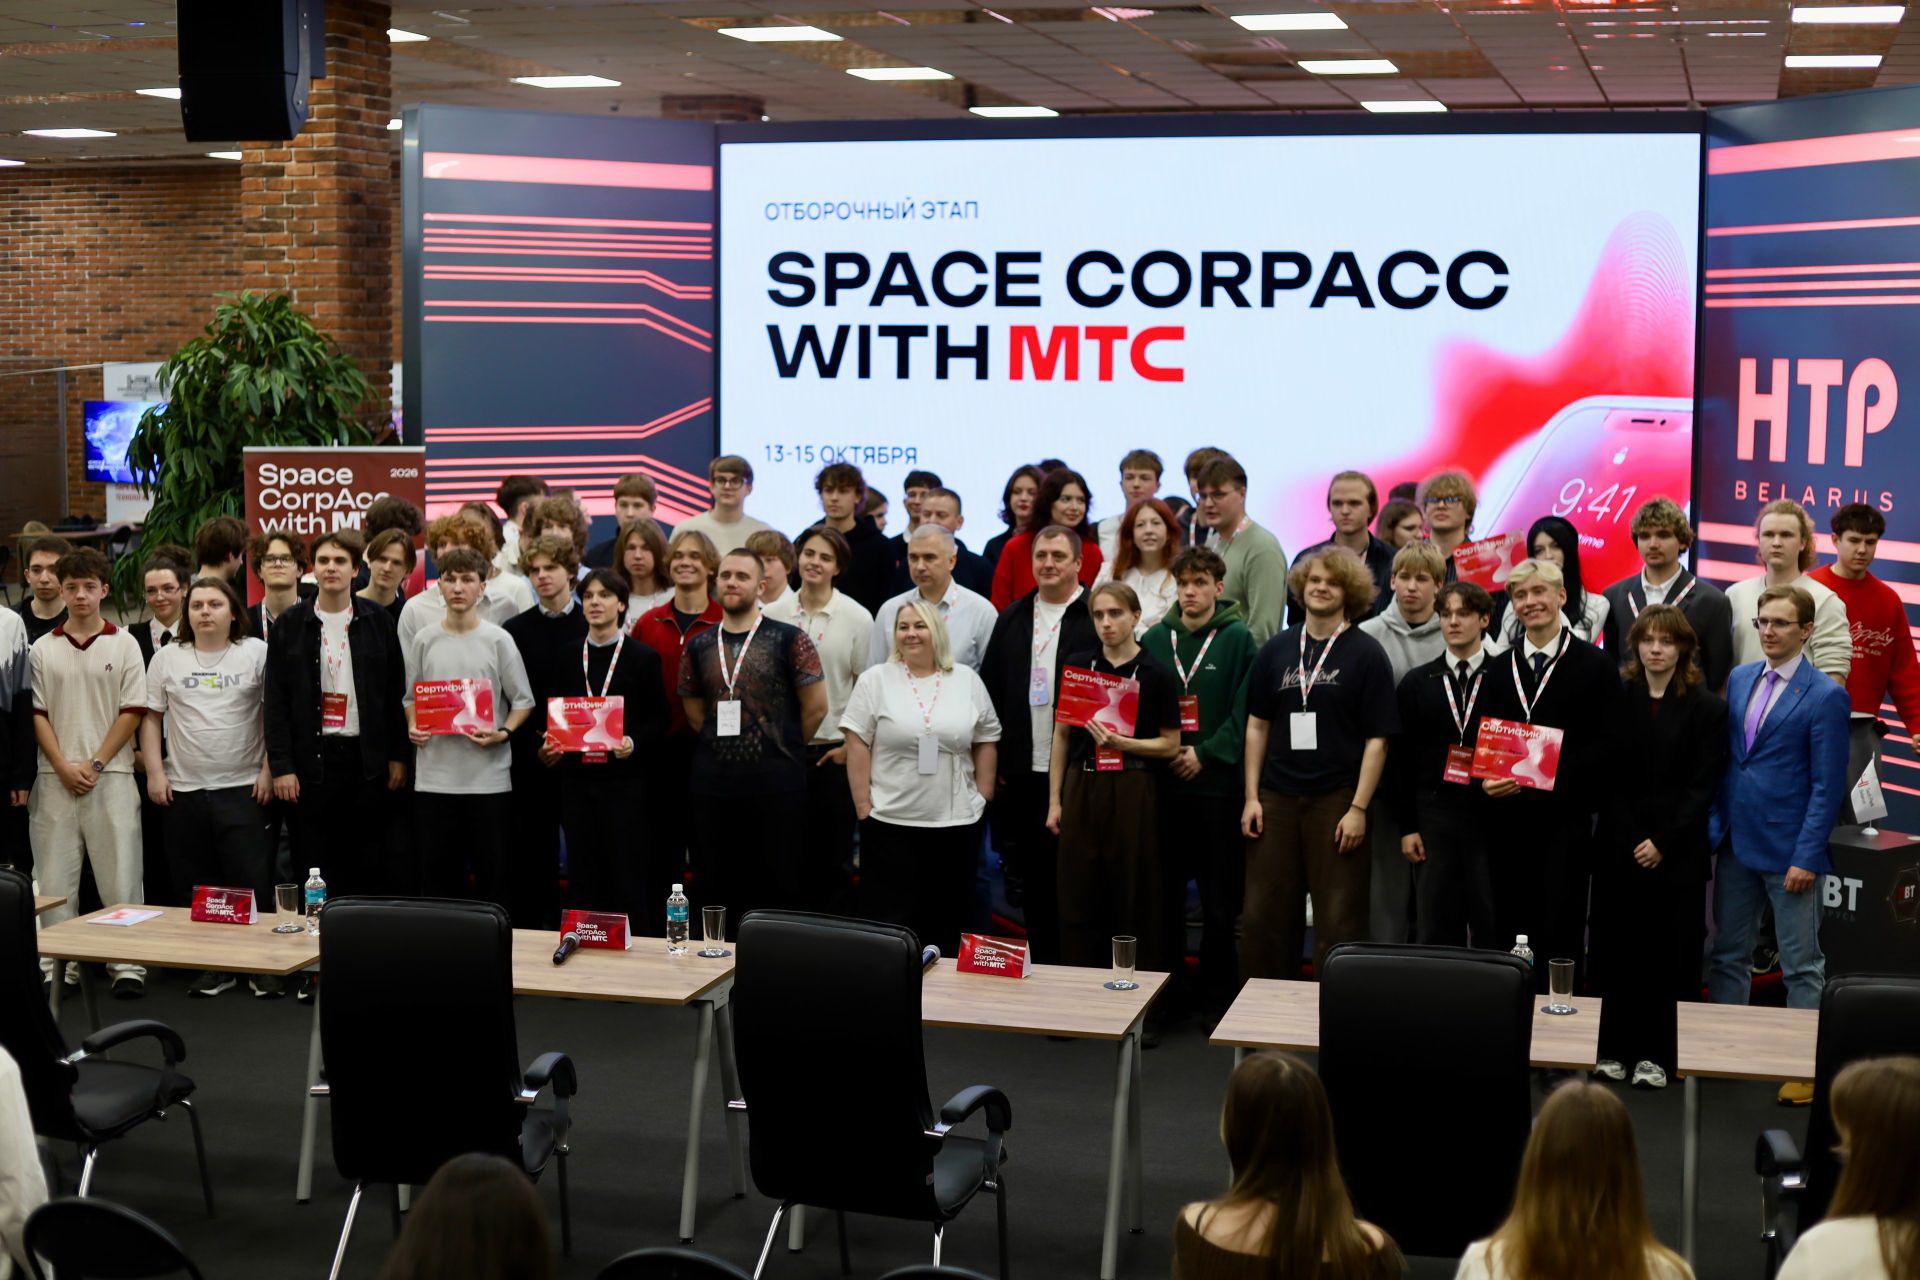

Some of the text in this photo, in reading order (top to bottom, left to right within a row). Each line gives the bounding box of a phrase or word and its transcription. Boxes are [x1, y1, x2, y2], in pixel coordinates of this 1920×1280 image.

[765, 196, 979, 221] ОТБОРОЧНЫЙ ЭТАП
[767, 249, 1510, 310] SPACE CORPACC
[766, 324, 990, 380] WITH
[1736, 356, 1899, 467] HTP
[765, 444, 918, 468] 13-15 ОКТЯБРЯ
[258, 463, 354, 490] Space
[390, 467, 419, 478] 2026
[1552, 478, 1637, 524] 9:41
[1734, 480, 1894, 512] BELARUS
[258, 511, 327, 535] with
[1063, 669, 1130, 690] Сертификат
[975, 947, 997, 955] Space
